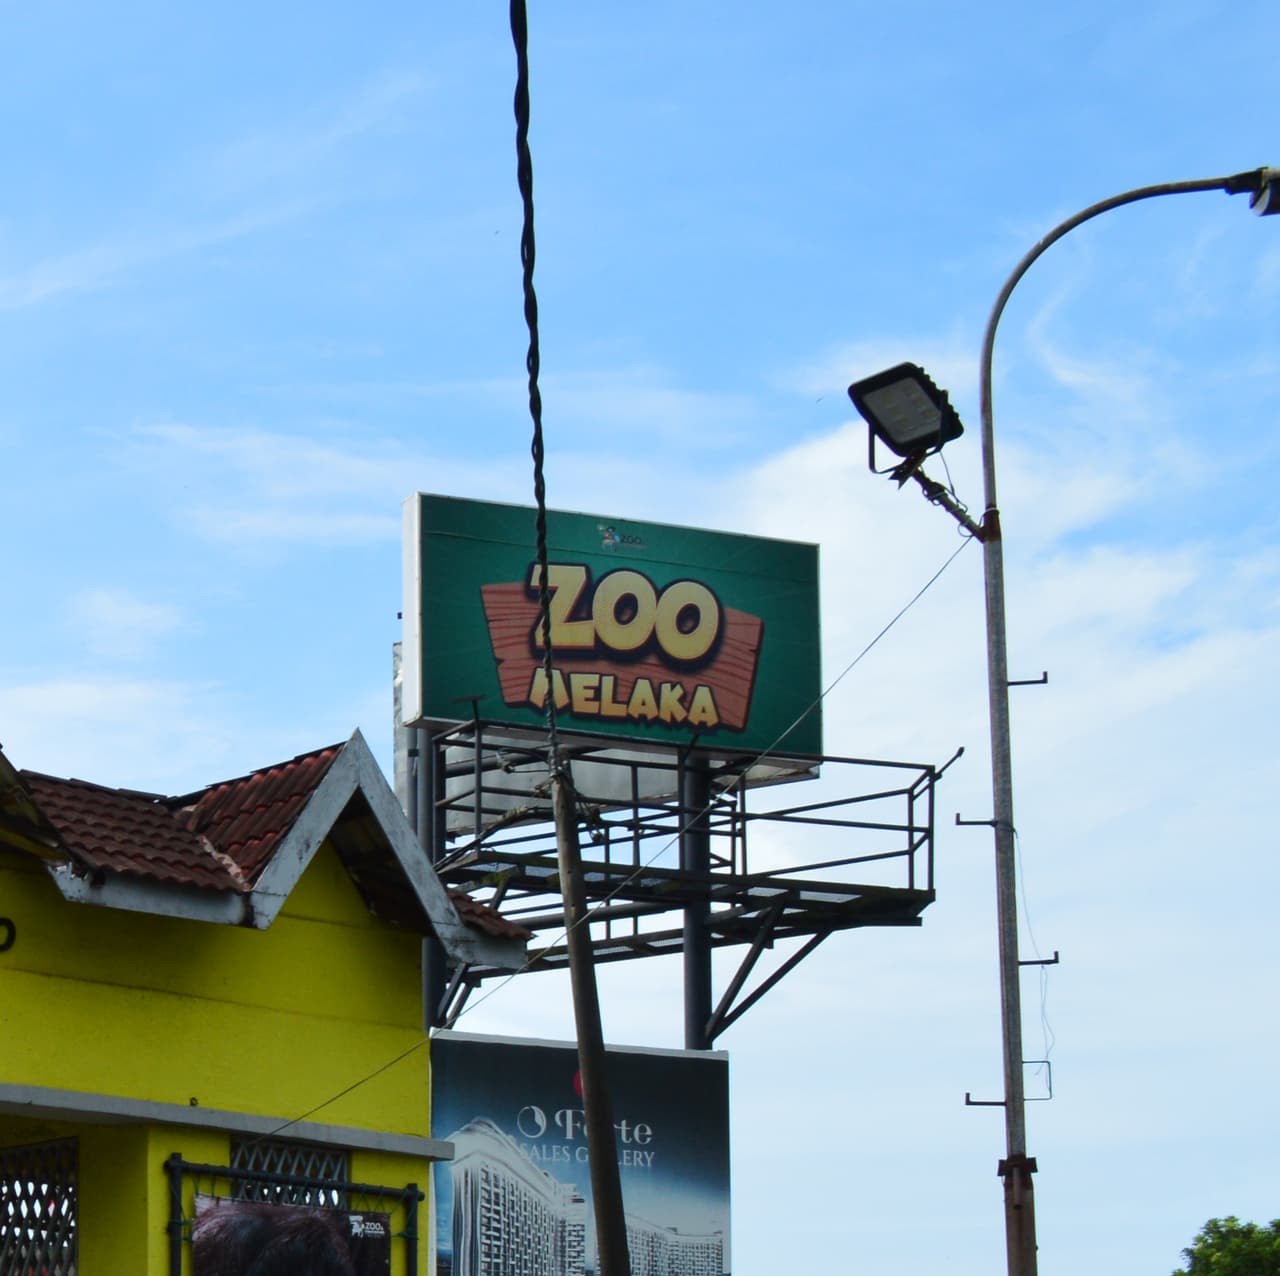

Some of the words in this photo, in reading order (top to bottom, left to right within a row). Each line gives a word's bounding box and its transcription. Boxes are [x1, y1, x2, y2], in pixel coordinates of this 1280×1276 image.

[528, 562, 721, 663] ZOO
[528, 666, 719, 729] MELAKA
[554, 1108, 653, 1145] Fte
[519, 1143, 571, 1162] SALES
[575, 1147, 655, 1168] GERY
